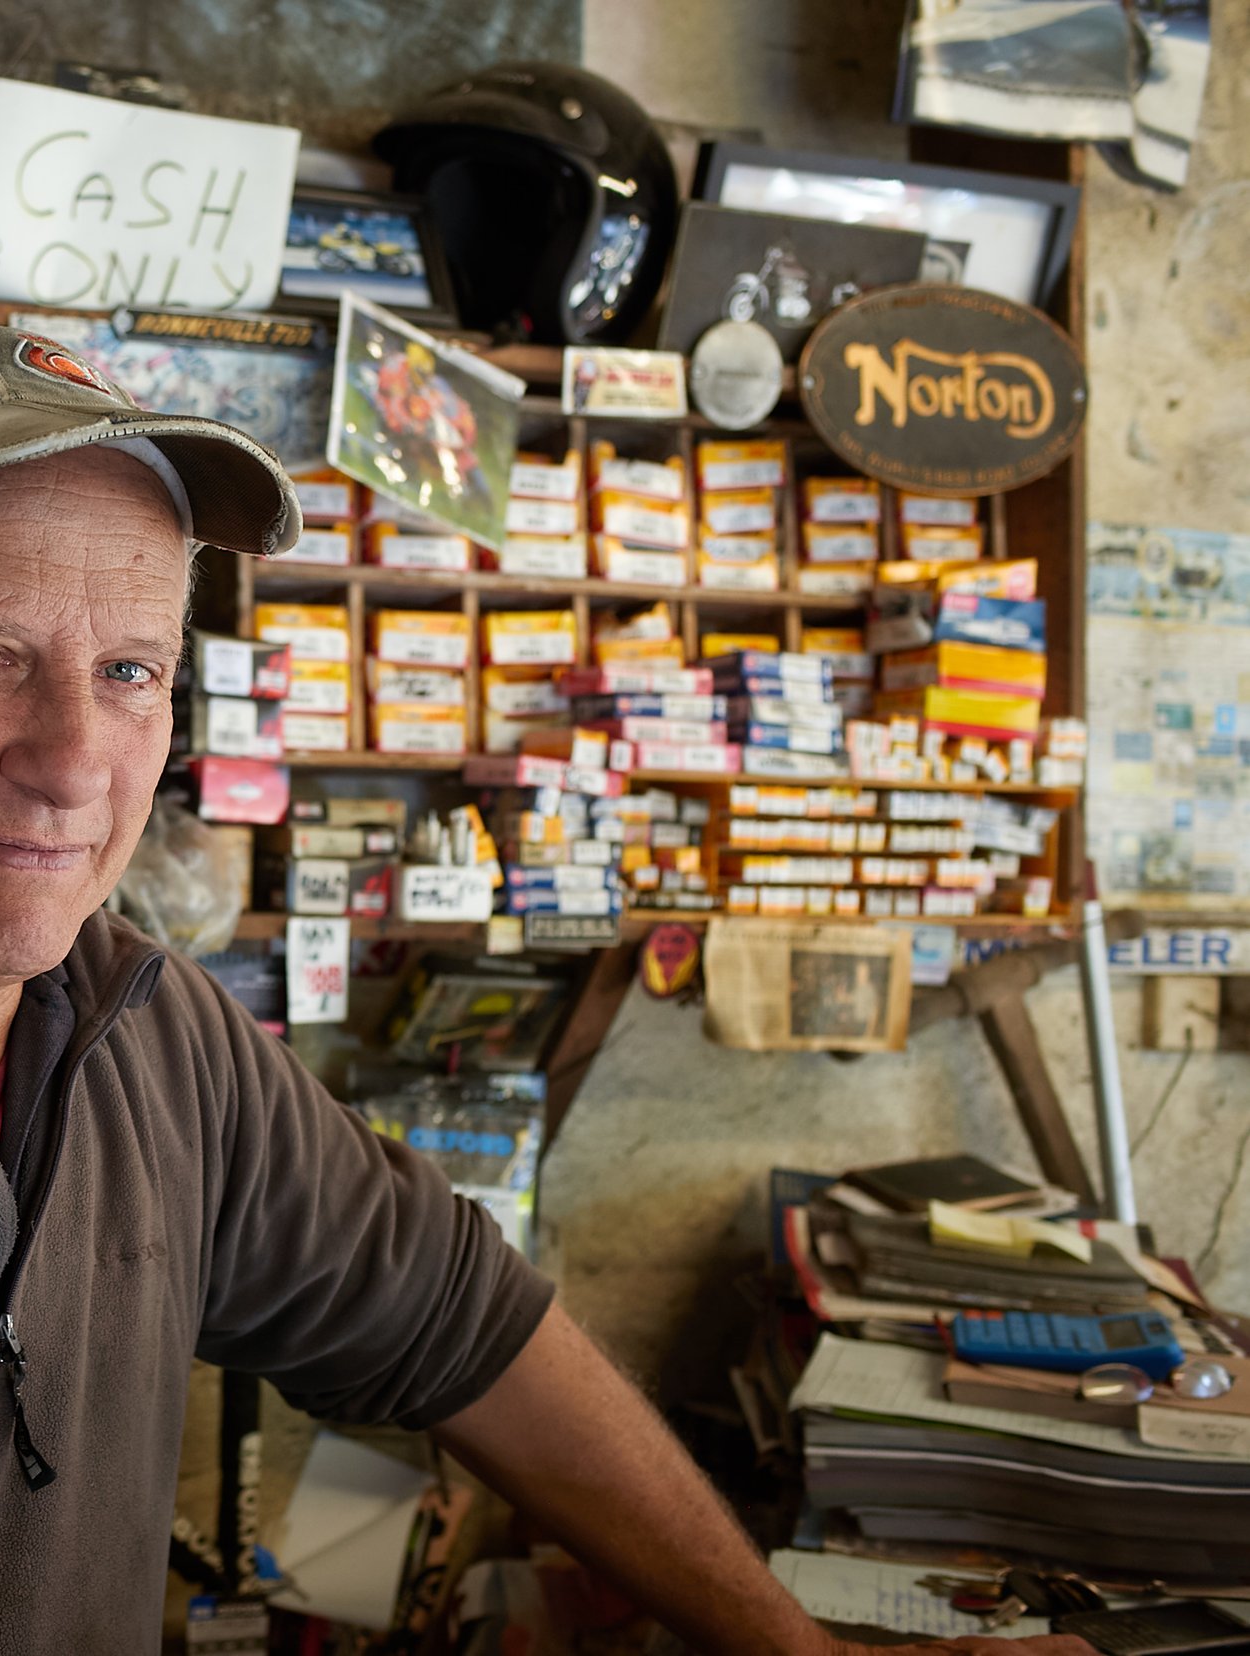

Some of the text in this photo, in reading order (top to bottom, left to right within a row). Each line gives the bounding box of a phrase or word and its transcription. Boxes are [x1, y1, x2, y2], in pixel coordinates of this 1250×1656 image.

[15, 130, 247, 251] CASH
[28, 241, 254, 309] ONLY
[134, 313, 270, 343] BONNEVILLE
[844, 337, 1055, 440] Norton
